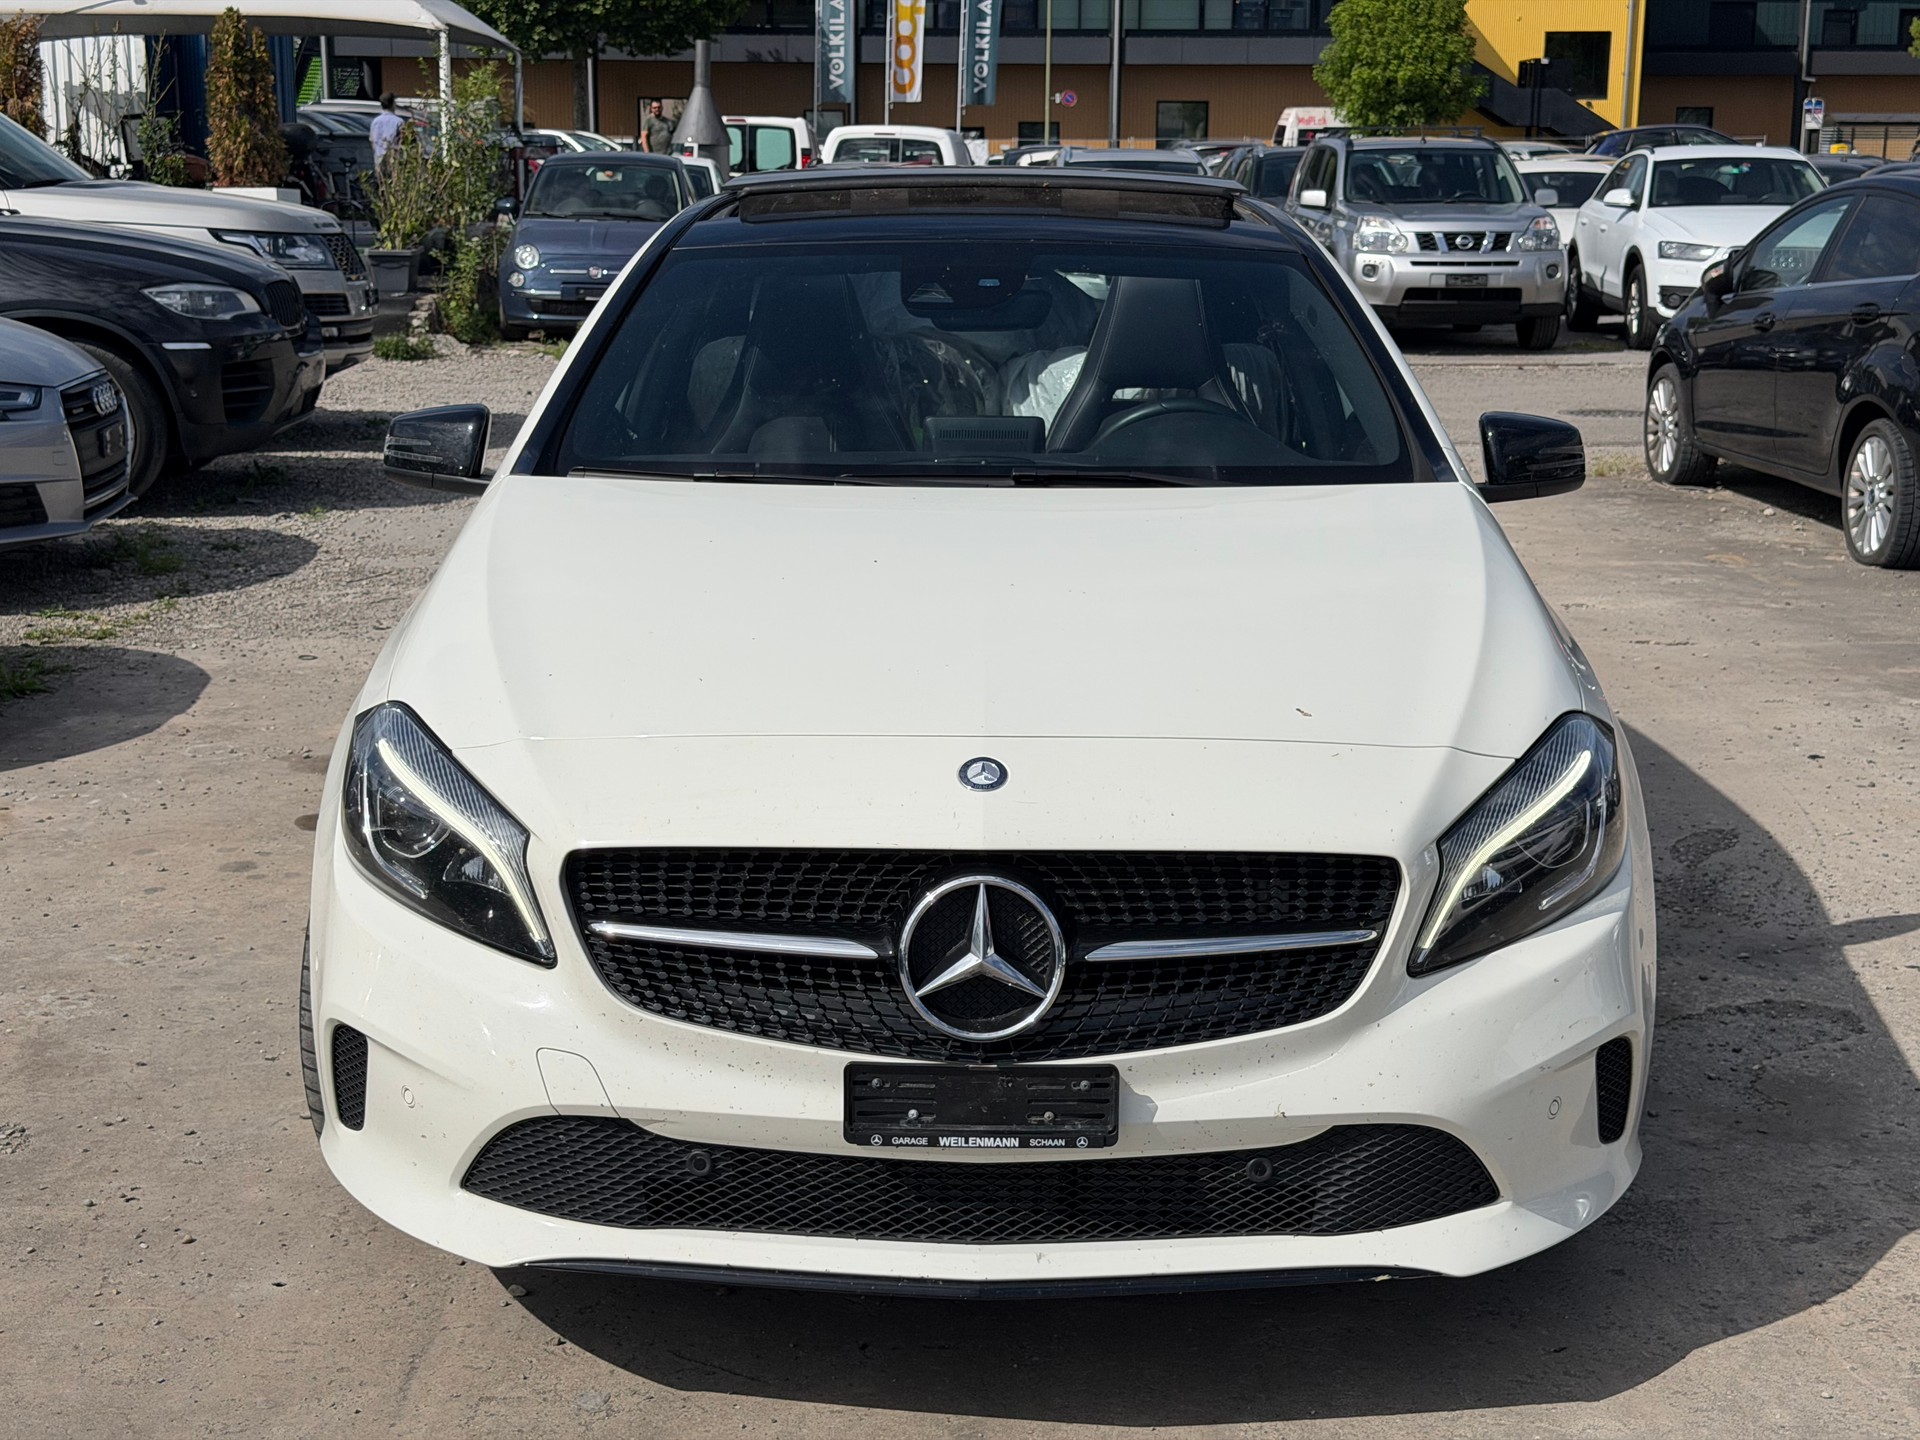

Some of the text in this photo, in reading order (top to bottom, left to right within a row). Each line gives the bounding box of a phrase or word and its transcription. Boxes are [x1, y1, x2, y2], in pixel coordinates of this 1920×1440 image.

[891, 1136, 1066, 1147] GARAGE WEILENMANN SCHAAN
